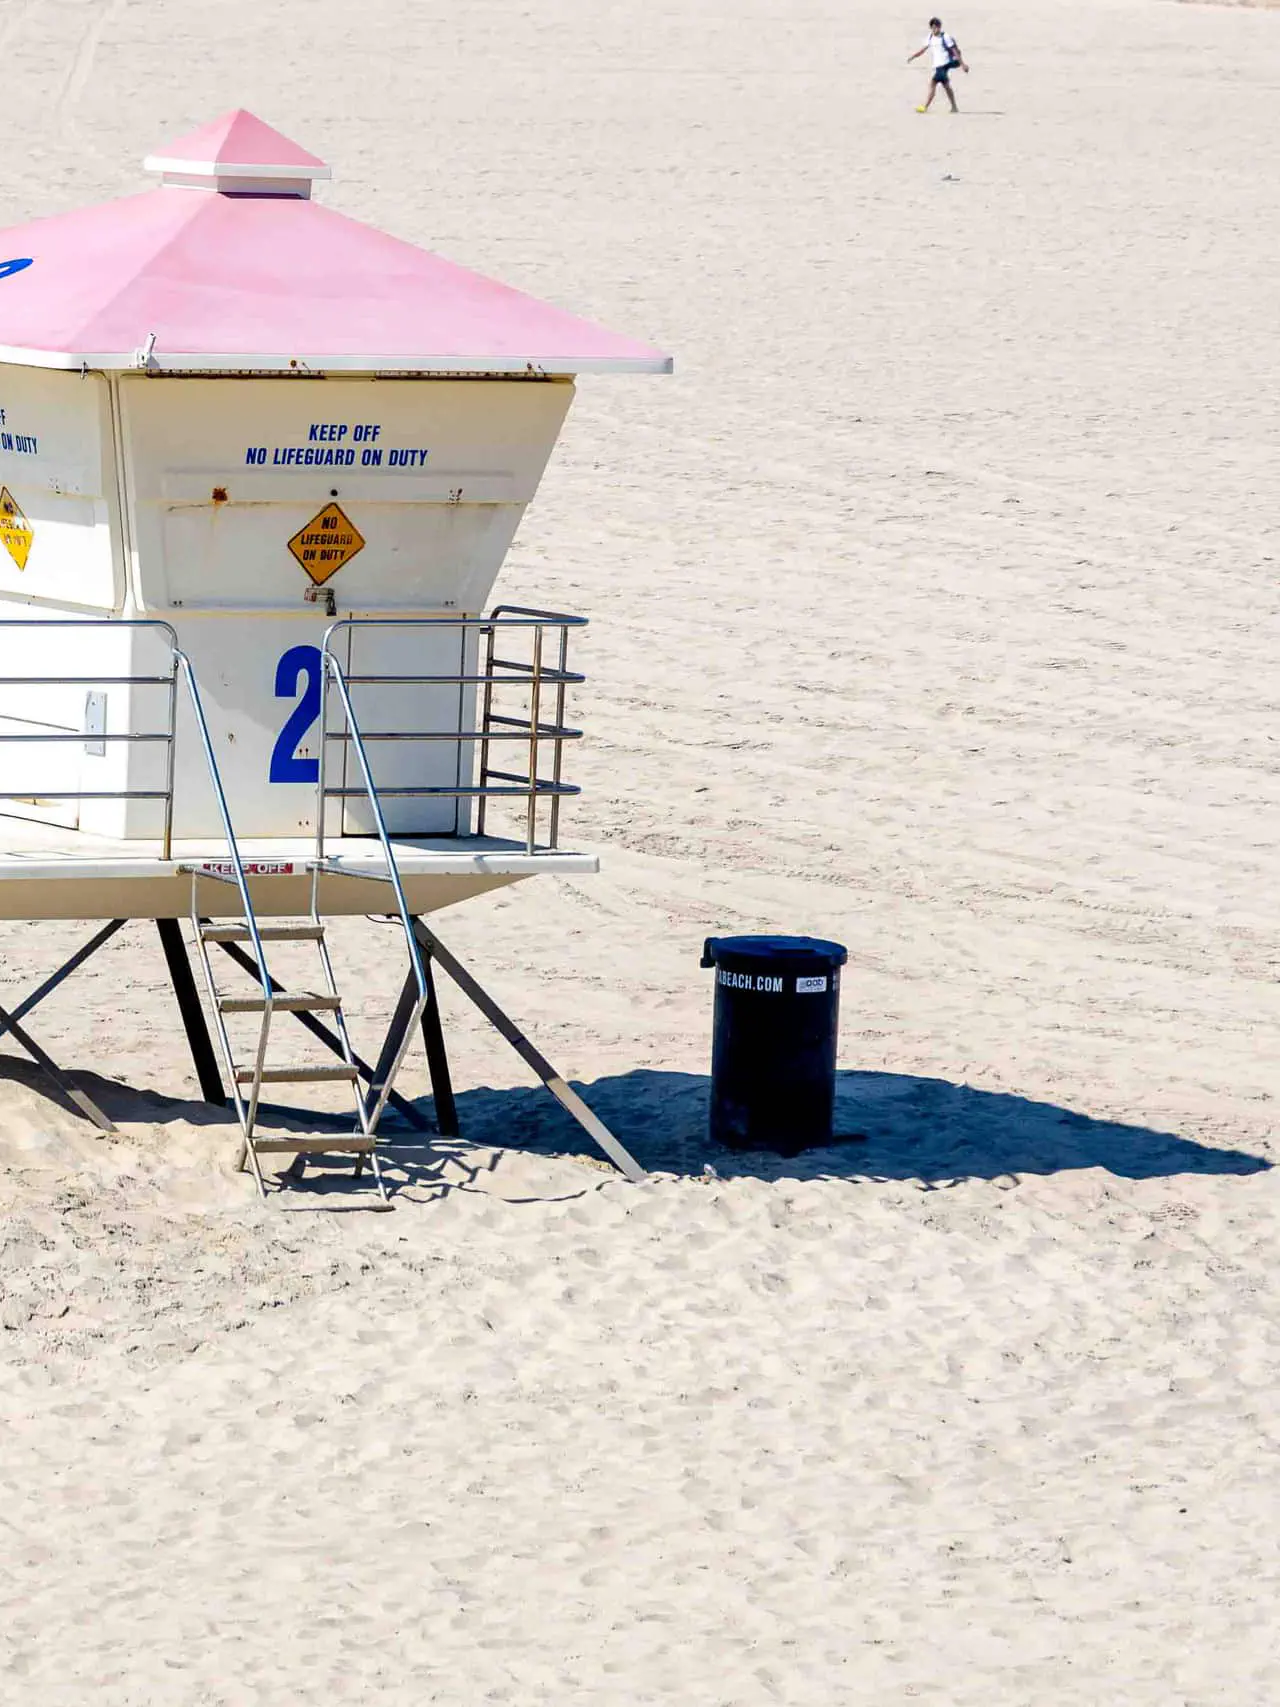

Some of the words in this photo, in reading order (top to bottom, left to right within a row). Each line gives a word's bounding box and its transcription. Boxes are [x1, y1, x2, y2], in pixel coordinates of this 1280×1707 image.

[308, 424, 348, 442] KEEP
[353, 424, 381, 442] OFF
[1, 432, 13, 451] ON
[15, 435, 37, 454] DUTY
[245, 447, 267, 465] NO
[272, 448, 355, 466] LIFEGUARD
[361, 449, 383, 466] ON
[388, 449, 428, 466] DUTY
[321, 516, 338, 530] NO
[300, 533, 353, 545] LIFEGUARD
[302, 549, 317, 561] ON
[319, 549, 346, 561] DUTY
[269, 644, 322, 783] 2
[257, 862, 286, 874] OFF
